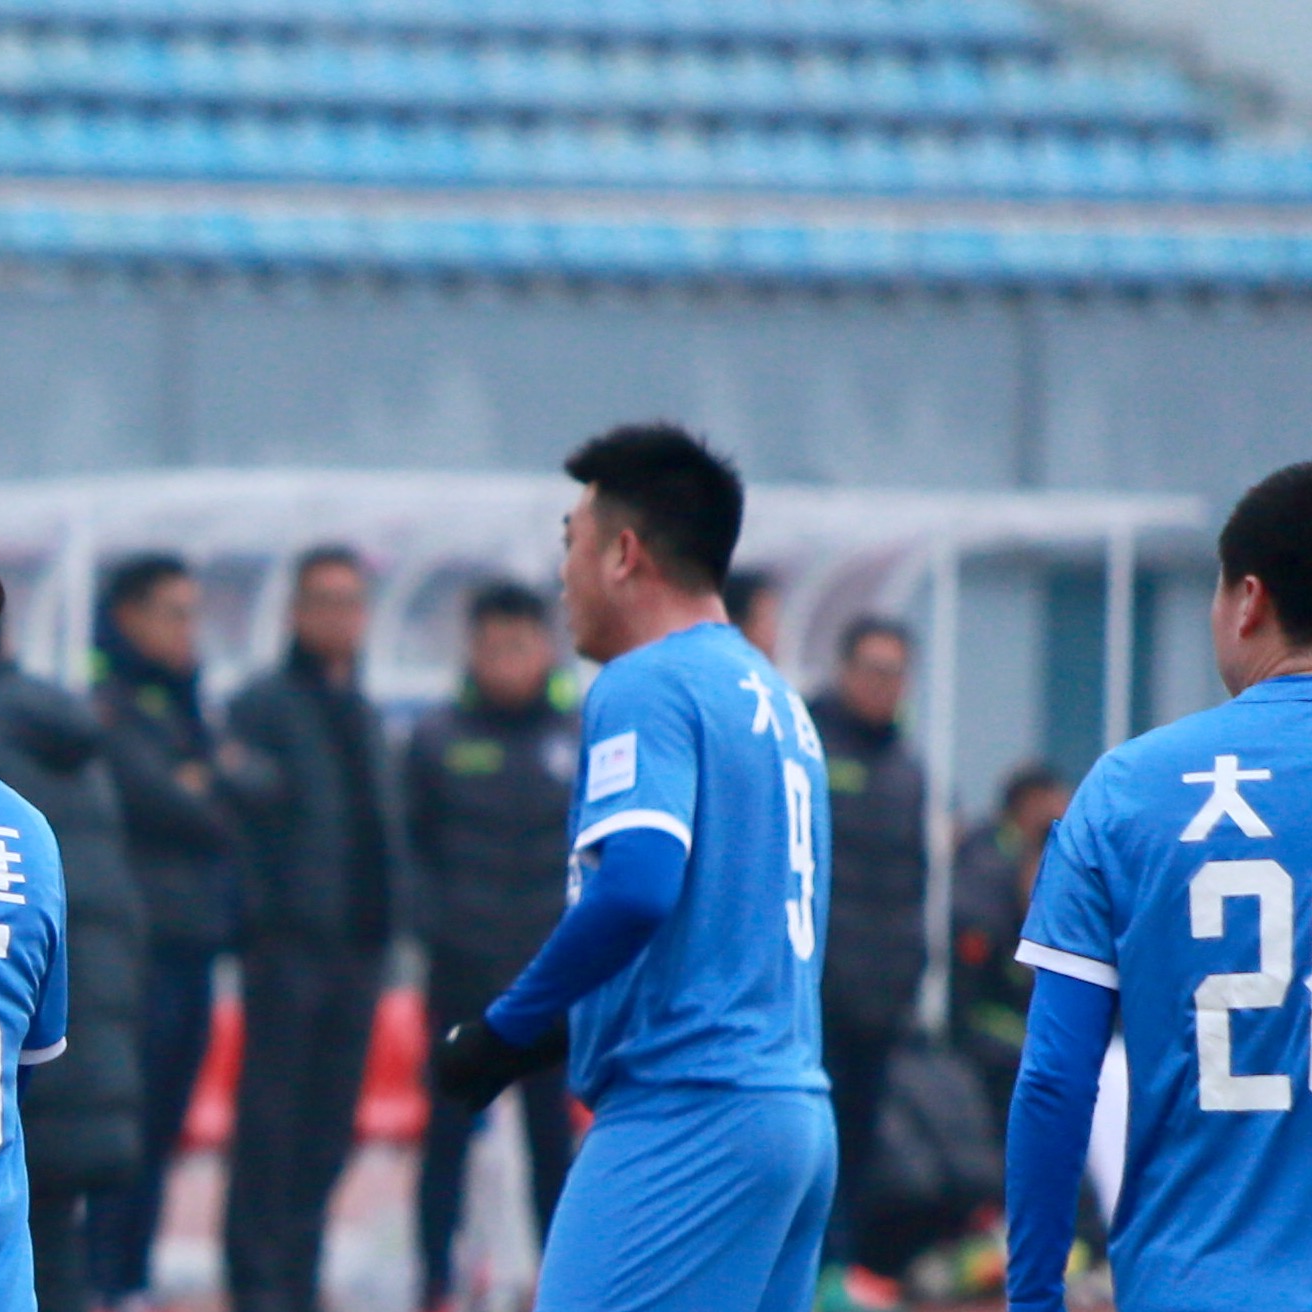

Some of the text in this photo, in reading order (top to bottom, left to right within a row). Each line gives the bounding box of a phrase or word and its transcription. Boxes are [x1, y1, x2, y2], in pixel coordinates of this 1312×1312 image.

[783, 757, 815, 962] 9
[1179, 754, 1274, 843] 大
[1189, 858, 1312, 1112] 2
